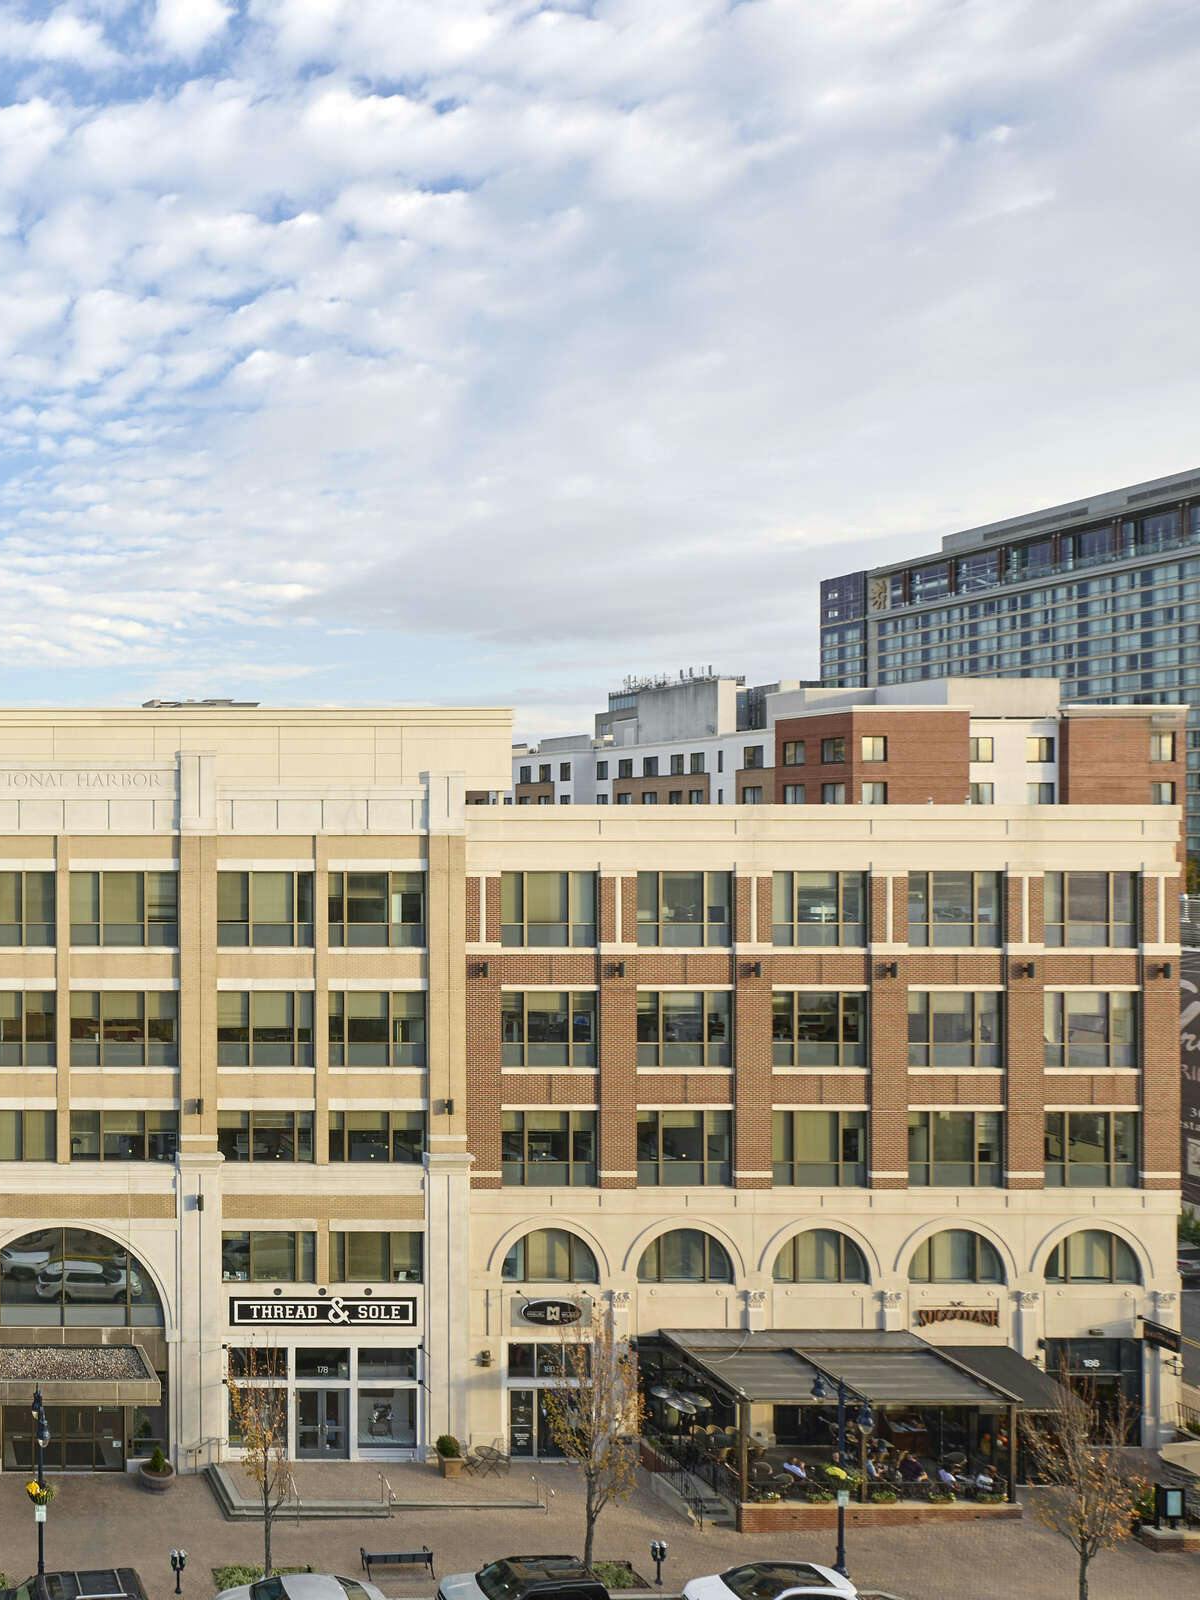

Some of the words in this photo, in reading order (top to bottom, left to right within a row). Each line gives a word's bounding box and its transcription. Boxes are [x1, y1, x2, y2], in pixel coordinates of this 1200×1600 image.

[76, 773, 161, 787] HARBOR
[250, 1305, 318, 1319] THREAD
[328, 1297, 351, 1325] &
[358, 1305, 401, 1320] SOLE
[317, 1366, 329, 1374] 178
